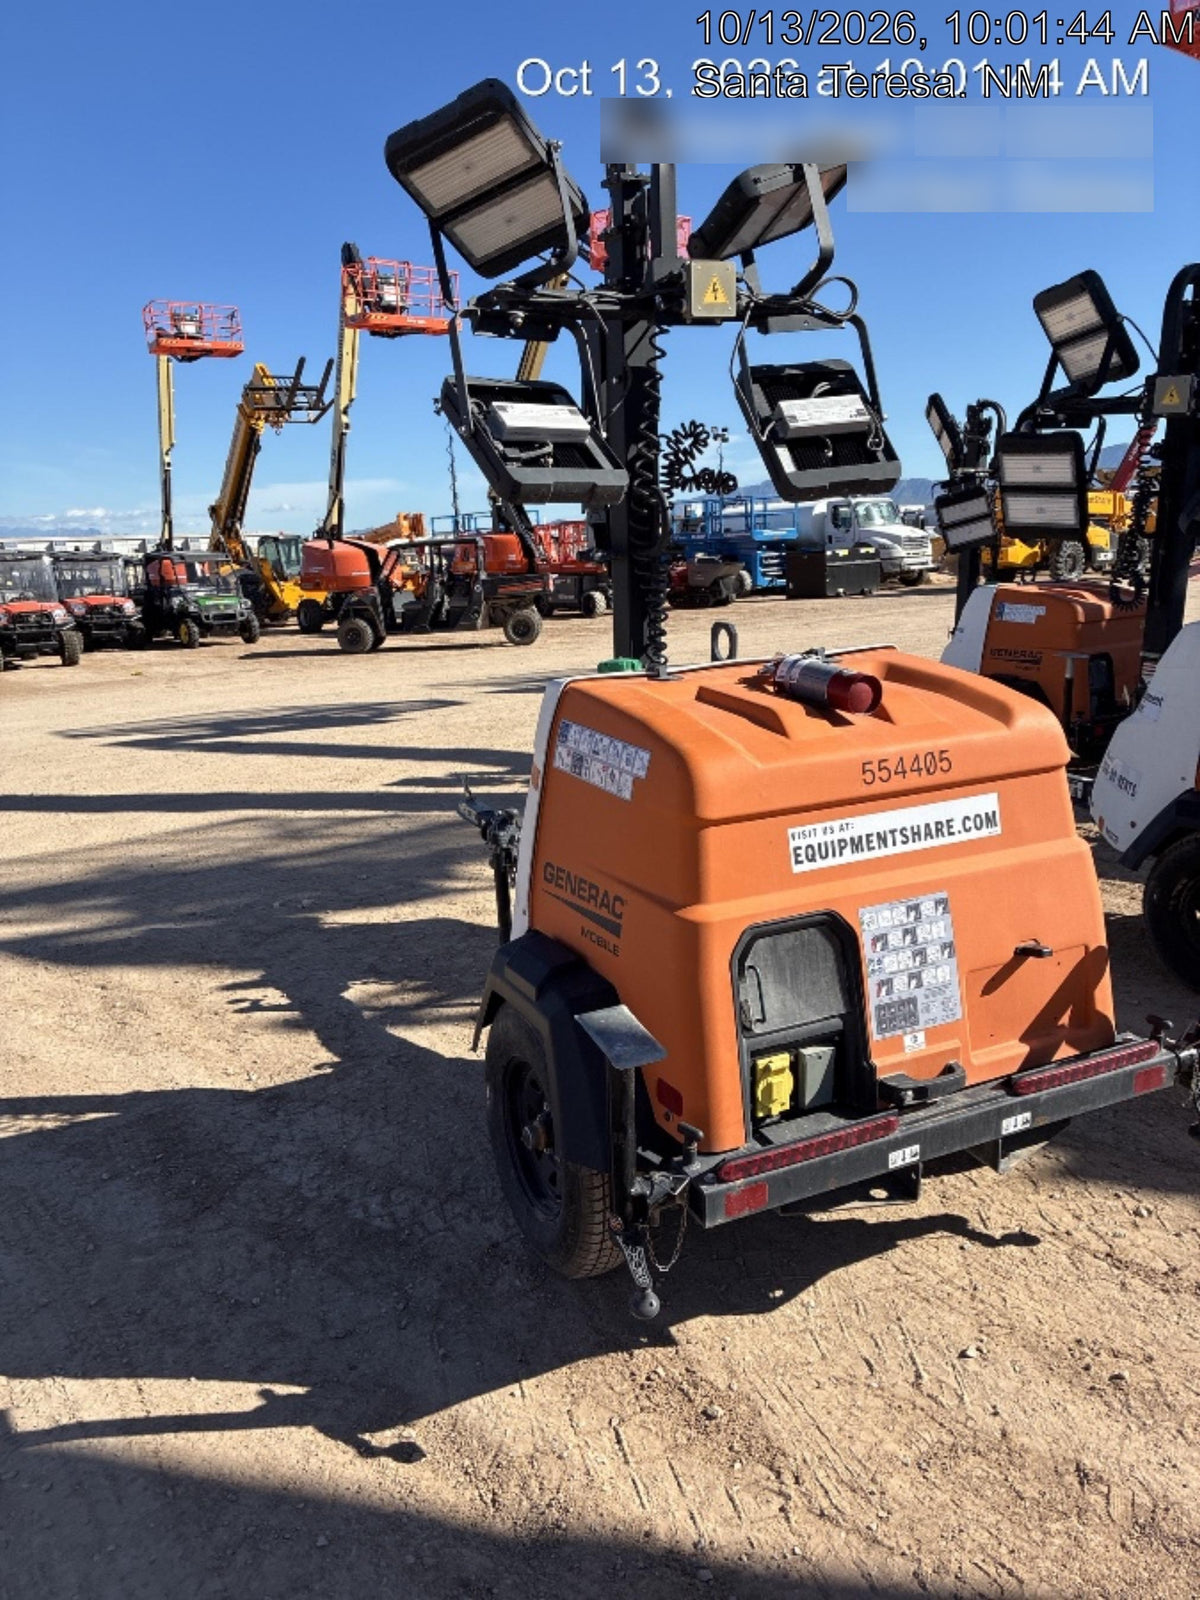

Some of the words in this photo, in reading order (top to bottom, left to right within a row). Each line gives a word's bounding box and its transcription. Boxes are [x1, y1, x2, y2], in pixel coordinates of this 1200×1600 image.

[861, 750, 953, 785] 554405
[790, 828, 818, 842] VISIT
[792, 810, 998, 865] EQUIPMENTSHARE.COM
[543, 861, 625, 920] GENERAC
[580, 925, 620, 957] MOBILE
